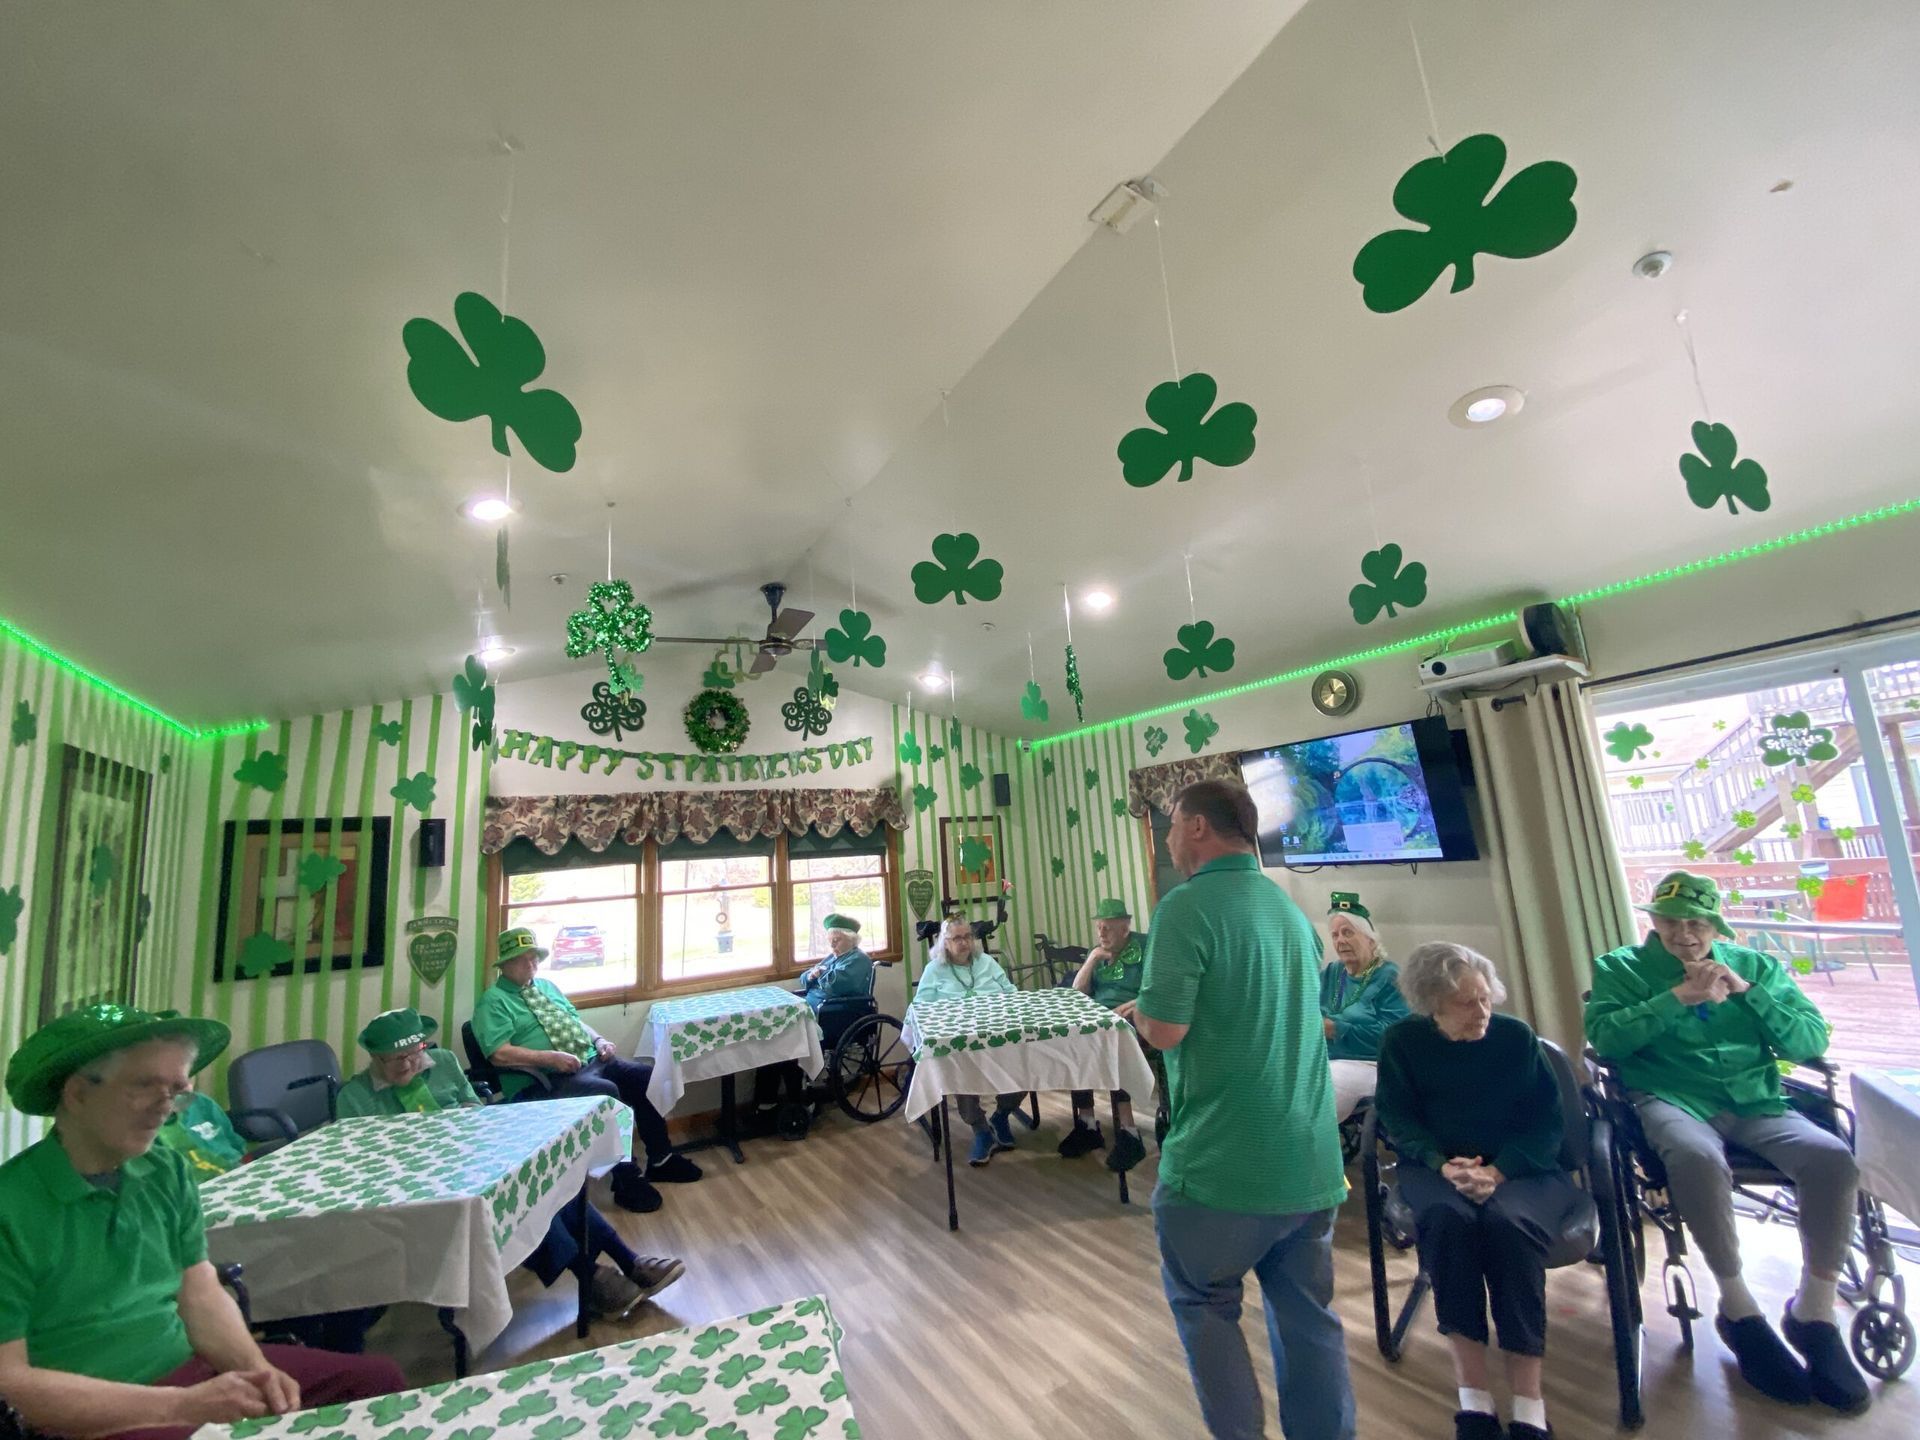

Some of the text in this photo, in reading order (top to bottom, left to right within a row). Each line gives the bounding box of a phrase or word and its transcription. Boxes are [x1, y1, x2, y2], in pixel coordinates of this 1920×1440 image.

[500, 730, 624, 776] HAPPY
[637, 752, 675, 780] ST
[827, 737, 872, 769] DAY
